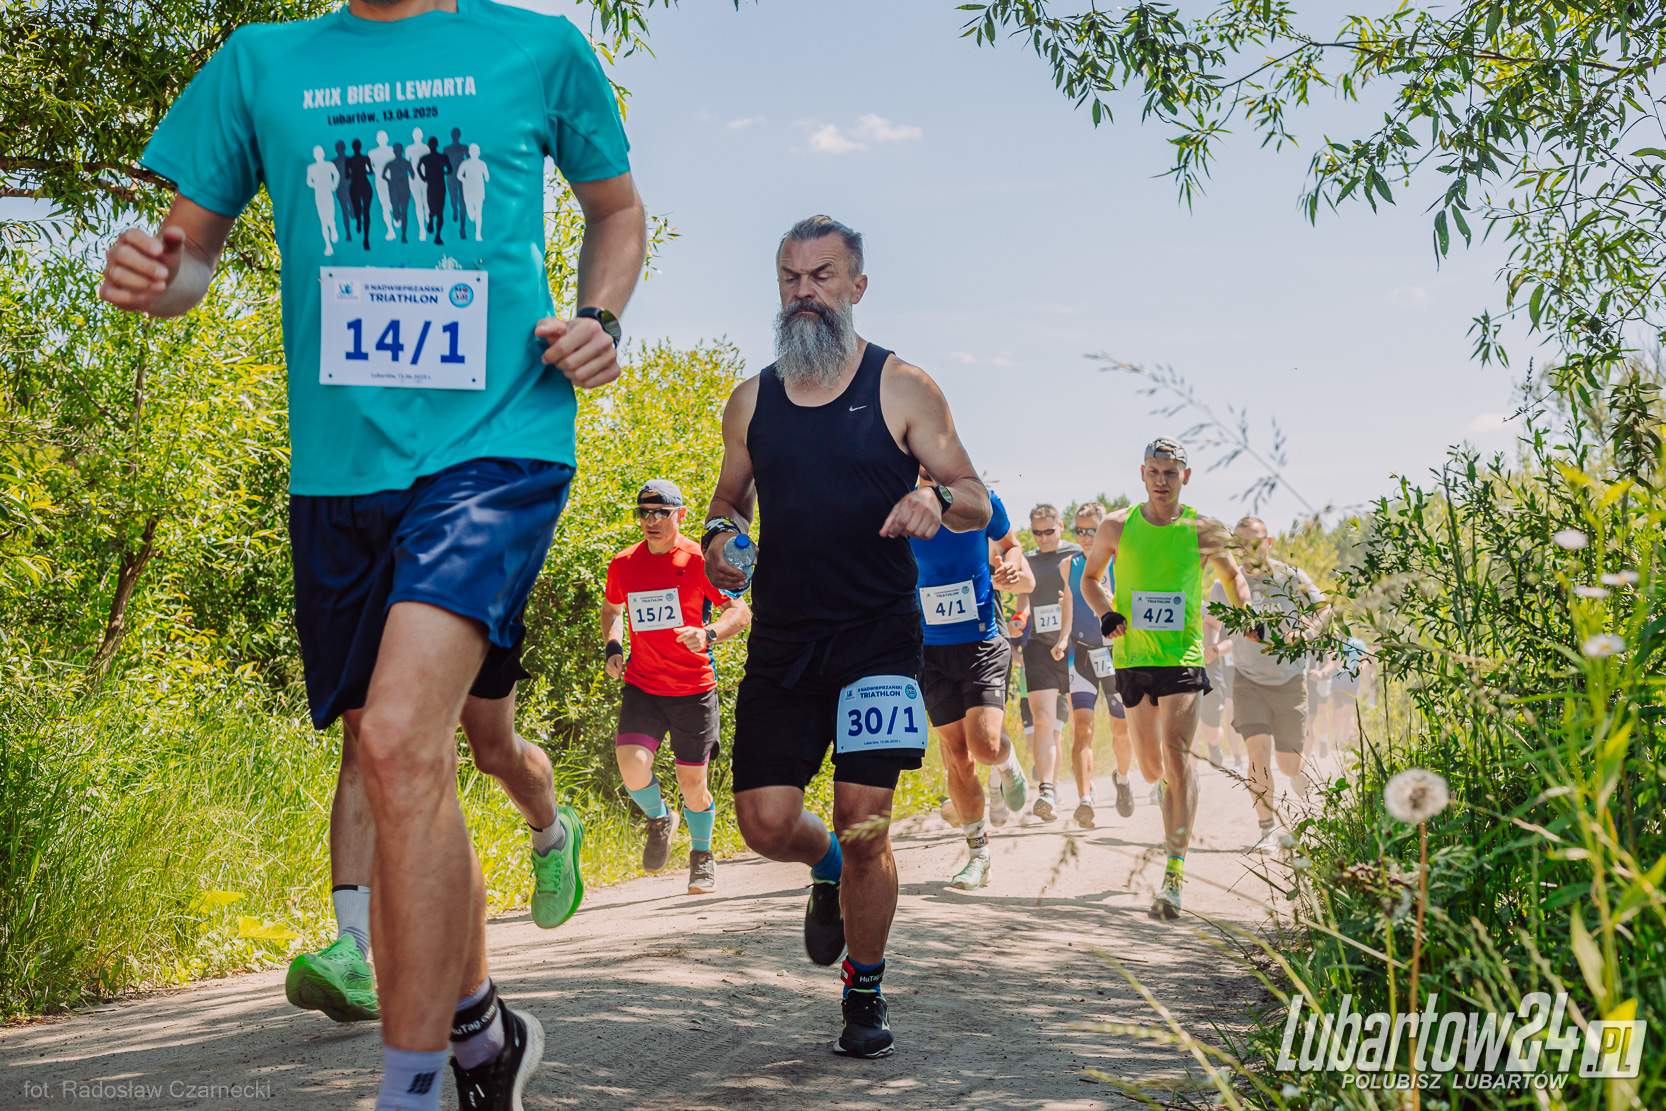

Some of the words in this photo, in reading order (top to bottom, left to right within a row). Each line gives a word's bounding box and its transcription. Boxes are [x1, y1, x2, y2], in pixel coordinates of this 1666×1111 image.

[303, 87, 341, 109] XXIX
[347, 82, 390, 105] BIEGI
[396, 76, 476, 100] LEWARTA
[327, 111, 380, 126] Lubartów,
[383, 106, 438, 122] 13.04.2025
[369, 293, 439, 304] TRIATHLON
[345, 318, 465, 365] 14/1
[636, 605, 676, 623] 15/2
[935, 600, 966, 617] 4/1
[1143, 608, 1174, 623] 4/2
[860, 690, 901, 699] TRIATHLON
[848, 706, 918, 736] 30/1
